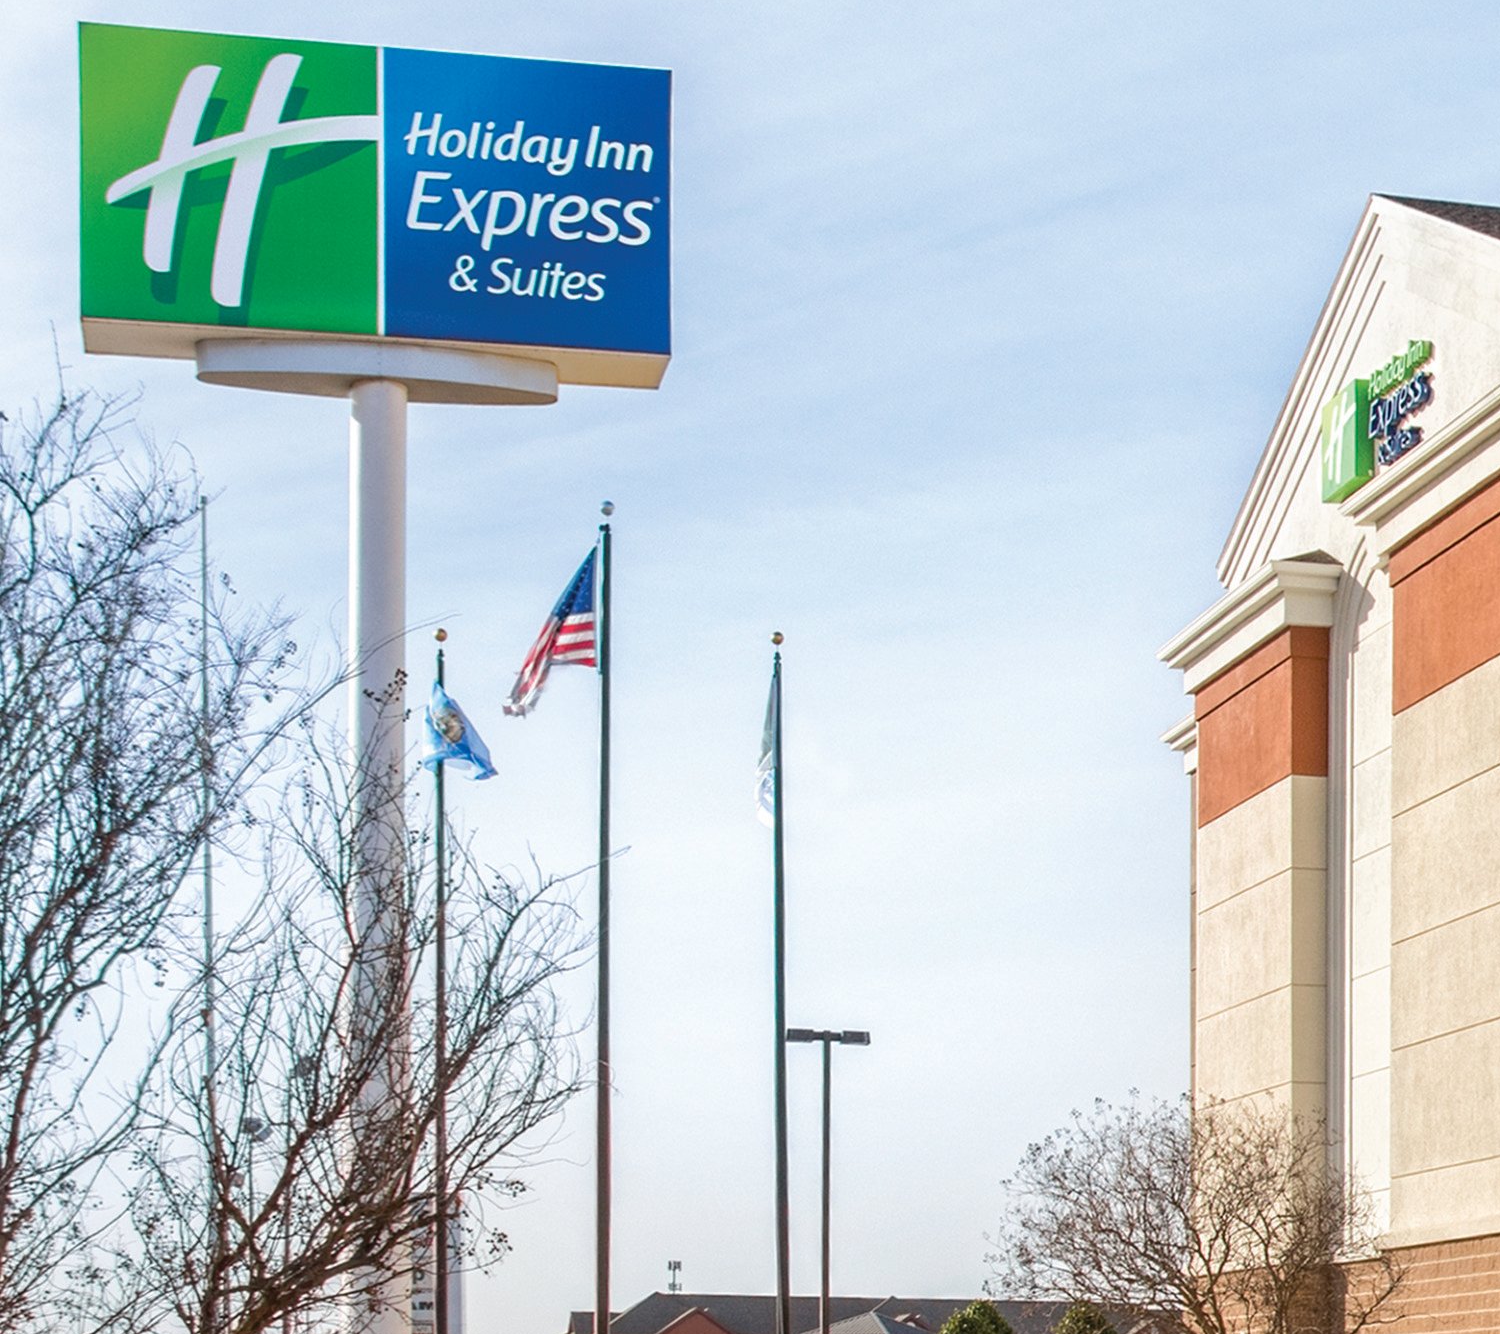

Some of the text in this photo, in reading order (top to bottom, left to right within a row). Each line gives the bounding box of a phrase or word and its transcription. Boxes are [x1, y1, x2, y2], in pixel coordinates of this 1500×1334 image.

[404, 111, 653, 176] Holiday Inn
[406, 170, 654, 252] Express
[449, 254, 606, 302] & Suites
[1368, 371, 1428, 439] Express
